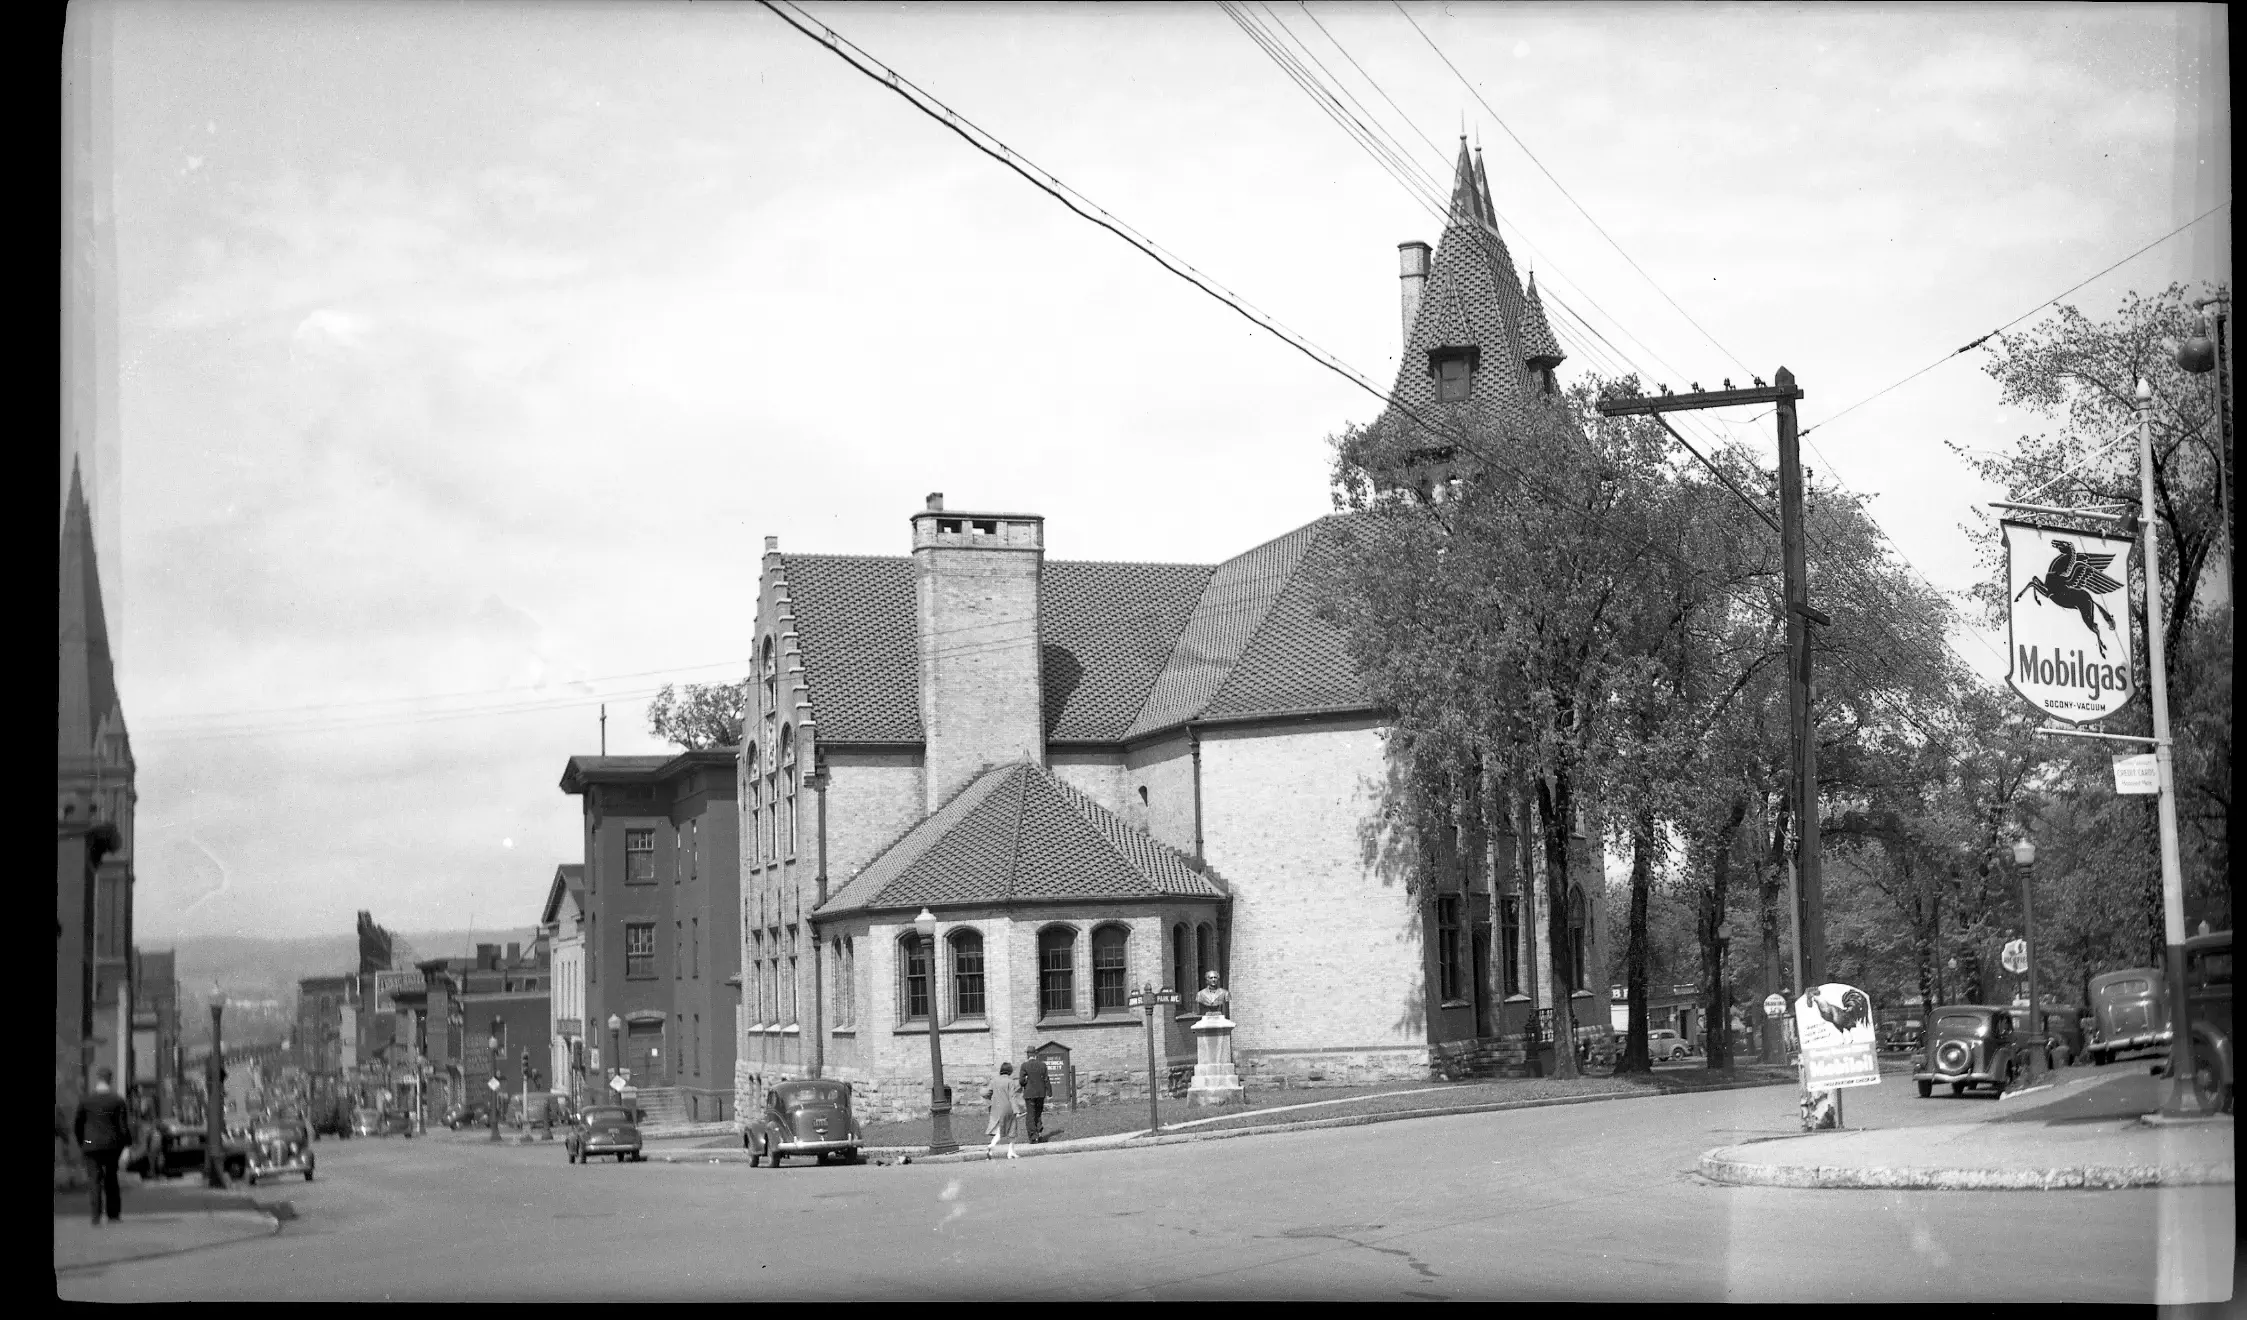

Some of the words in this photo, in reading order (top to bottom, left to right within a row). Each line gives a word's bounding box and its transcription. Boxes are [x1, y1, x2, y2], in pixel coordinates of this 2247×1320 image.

[2019, 644, 2127, 700] Mobilgas
[2044, 699, 2106, 711] SOCONY-VACUUM
[1157, 995, 1169, 1003] PARK
